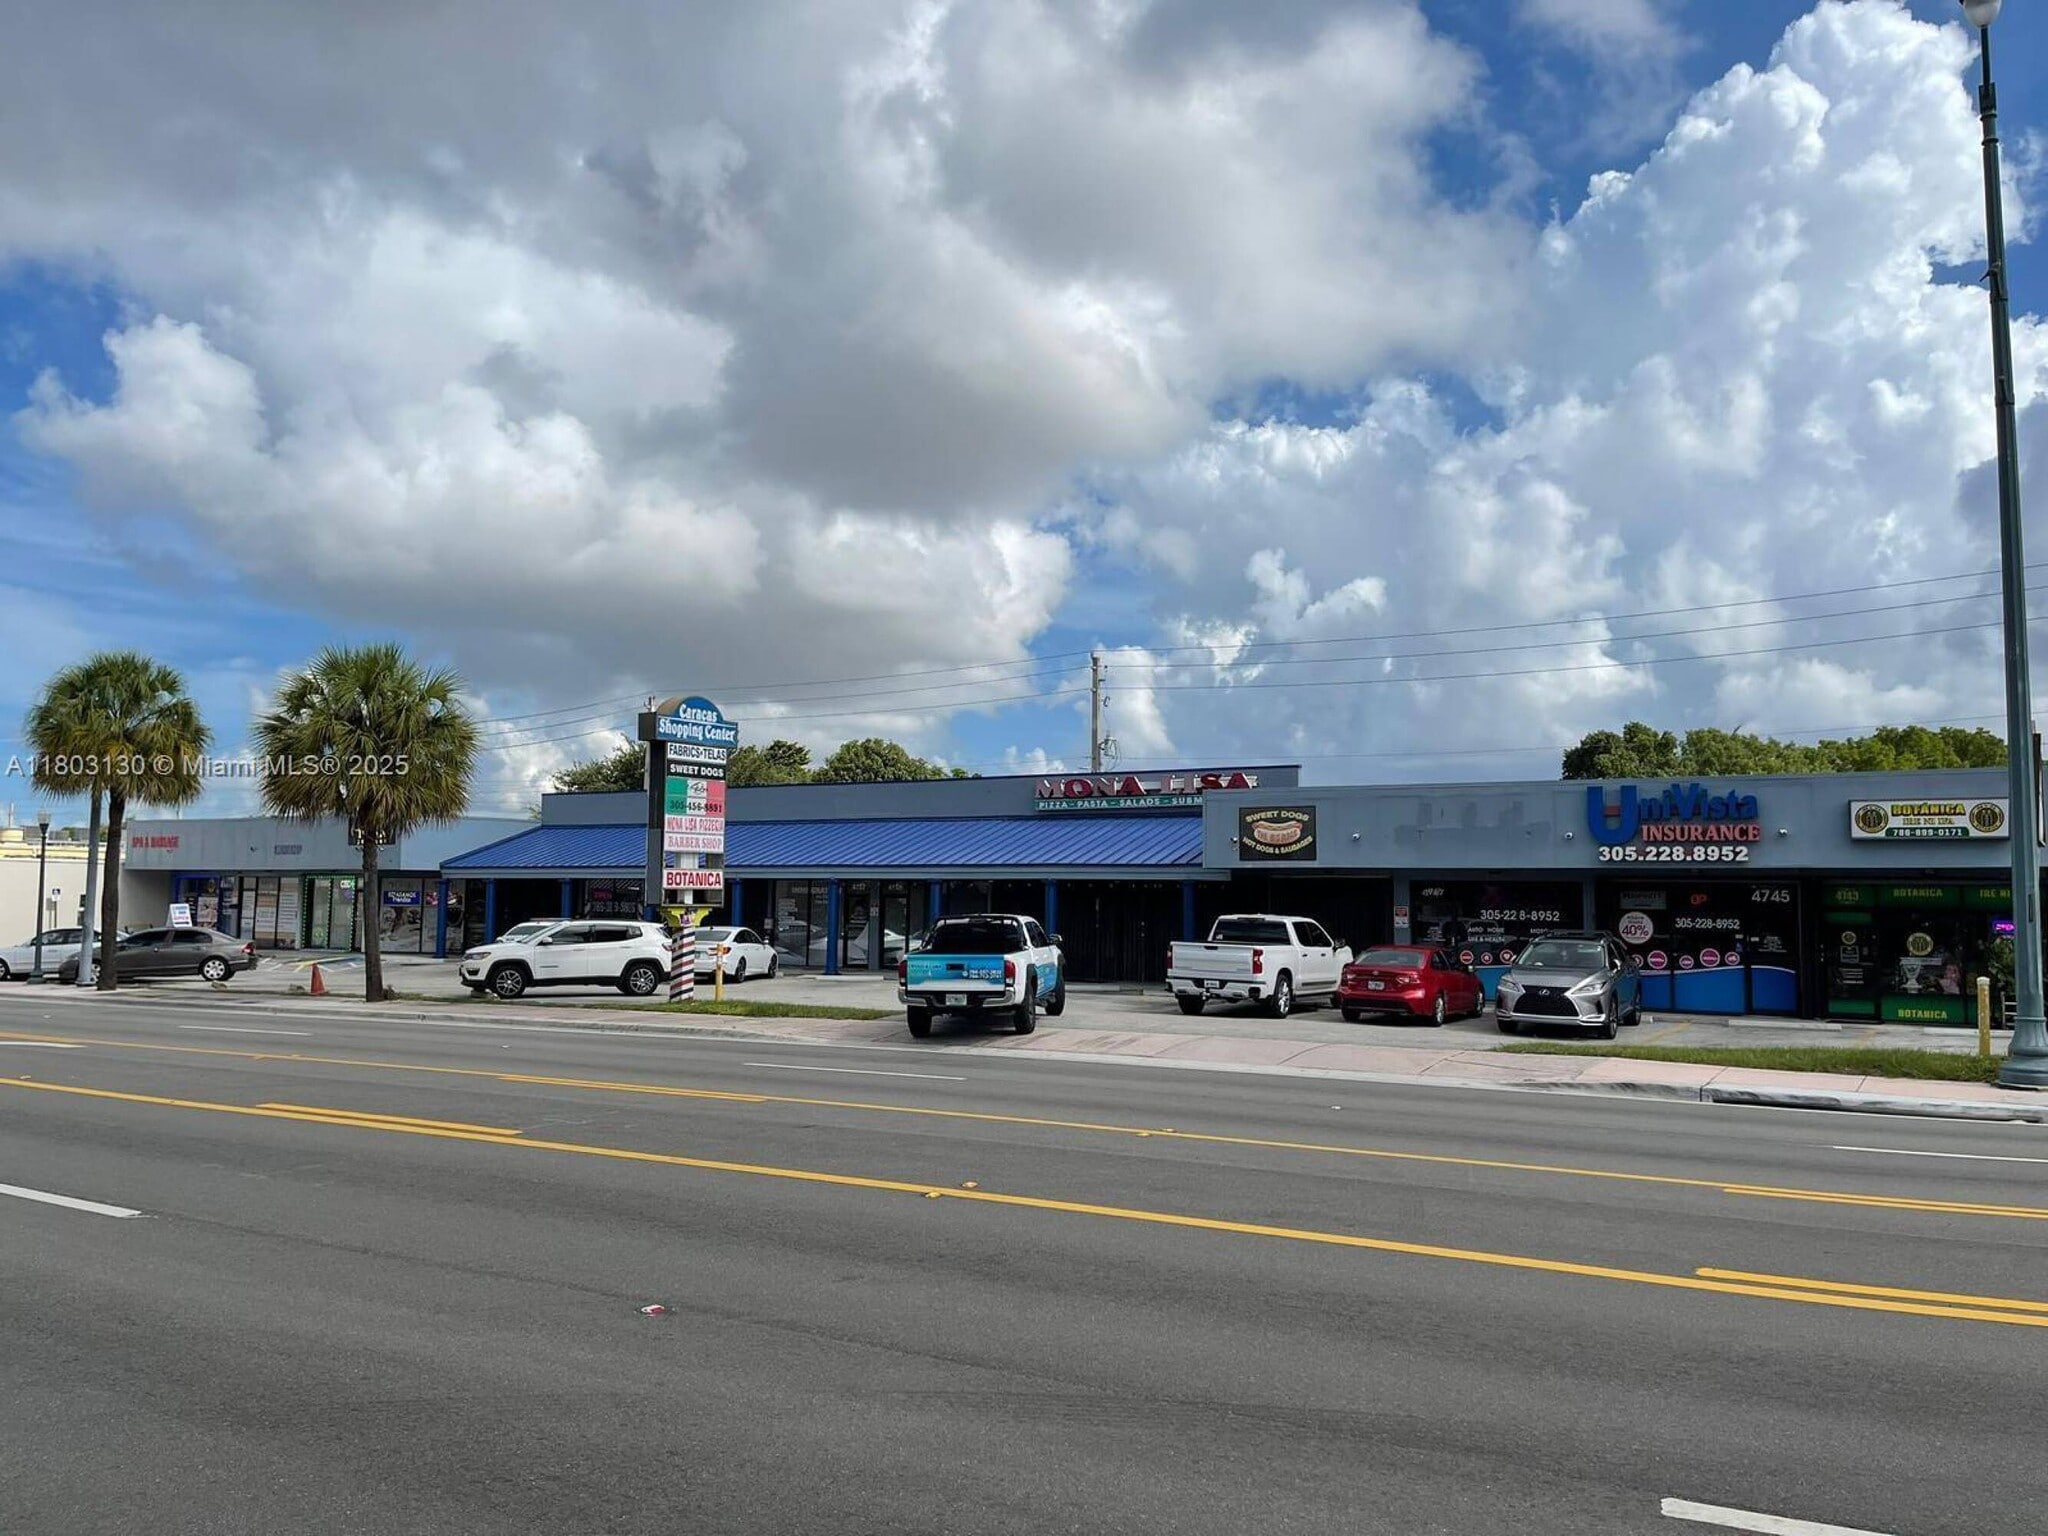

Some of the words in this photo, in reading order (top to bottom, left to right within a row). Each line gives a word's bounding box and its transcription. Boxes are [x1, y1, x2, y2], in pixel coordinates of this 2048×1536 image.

[679, 703, 718, 723] Caracas
[659, 718, 704, 741] Shopping
[704, 725, 737, 743] Center
[670, 763, 699, 775] SWEET
[701, 766, 724, 777] DOGS
[1035, 776, 1147, 799] MONA
[1160, 772, 1255, 795] LISA
[1038, 801, 1068, 810] PIZZA
[1077, 799, 1108, 809] PASTA
[1120, 798, 1161, 807] SALADS
[1245, 810, 1280, 822] SWEET
[1281, 810, 1310, 822] DOGS
[1641, 823, 1761, 843] INSURANCE
[668, 836, 700, 849] BARBER
[702, 838, 722, 850] SHOP
[1242, 836, 1256, 848] HOT
[1598, 845, 1749, 862] 305.228.8952
[666, 871, 721, 887] BOTANICA
[1751, 889, 1791, 903] 4745
[1893, 888, 1943, 897] BOTANICA
[1621, 924, 1650, 937] 40%
[1674, 917, 1740, 930] 305-228-8952
[1897, 1008, 1948, 1020] BOTANICA
